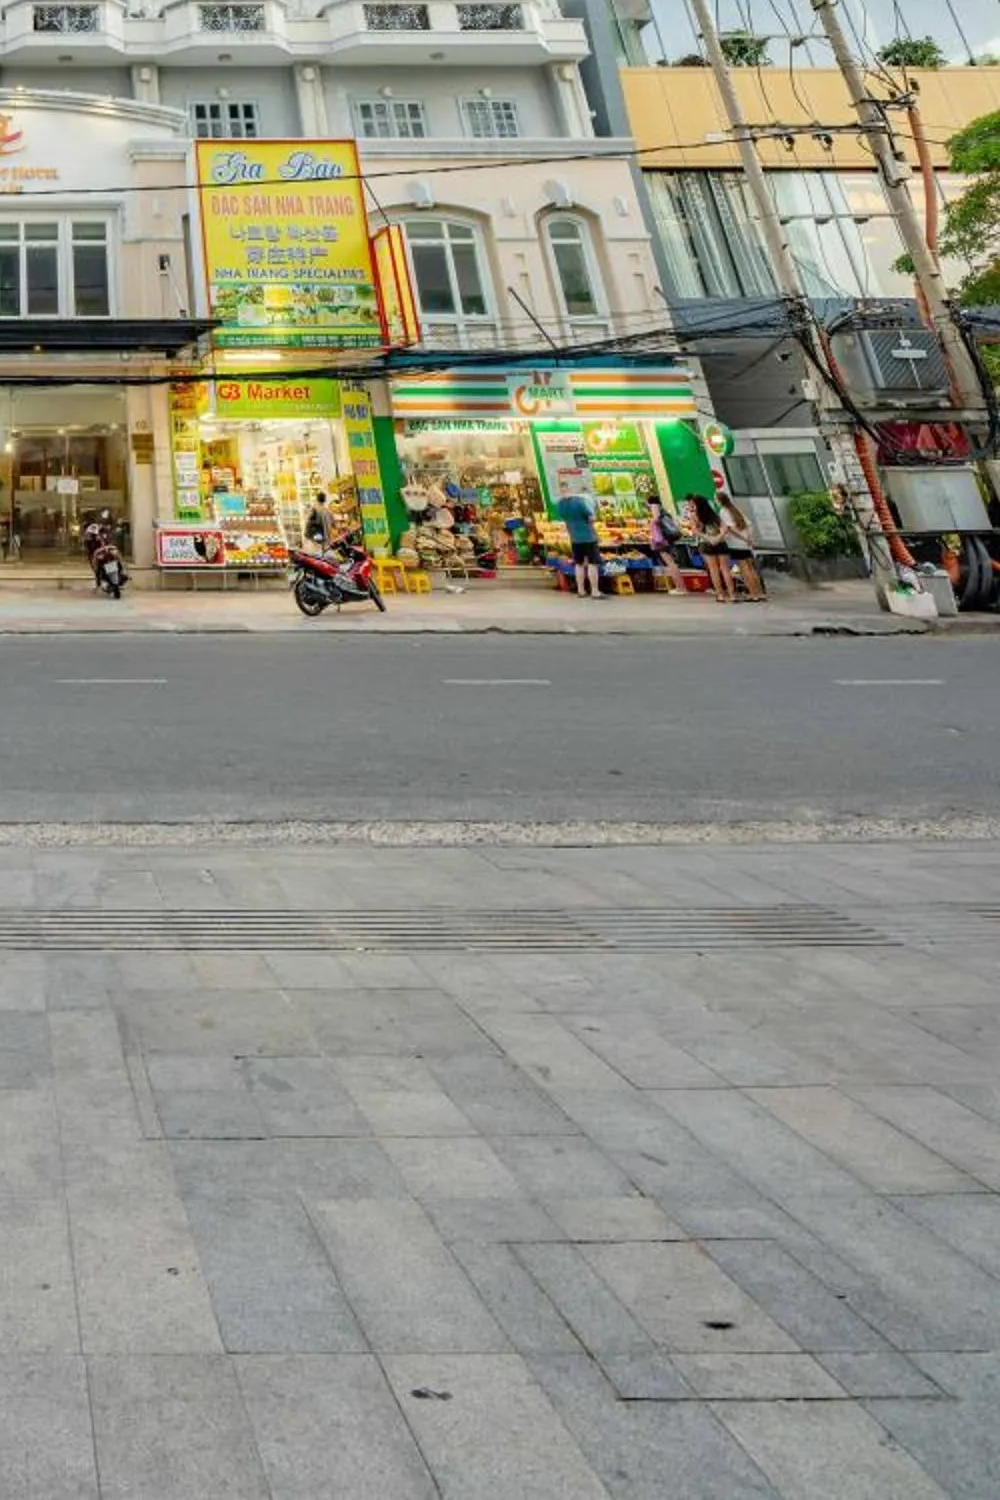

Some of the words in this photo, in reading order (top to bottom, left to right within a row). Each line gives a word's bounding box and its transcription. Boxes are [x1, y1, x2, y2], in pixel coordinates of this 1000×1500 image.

[212, 151, 264, 184] Gia
[276, 194, 305, 216] NHA
[308, 194, 355, 216] TRANG
[215, 268, 242, 279] NHA
[248, 268, 289, 279] TRANG
[247, 383, 310, 401] Market
